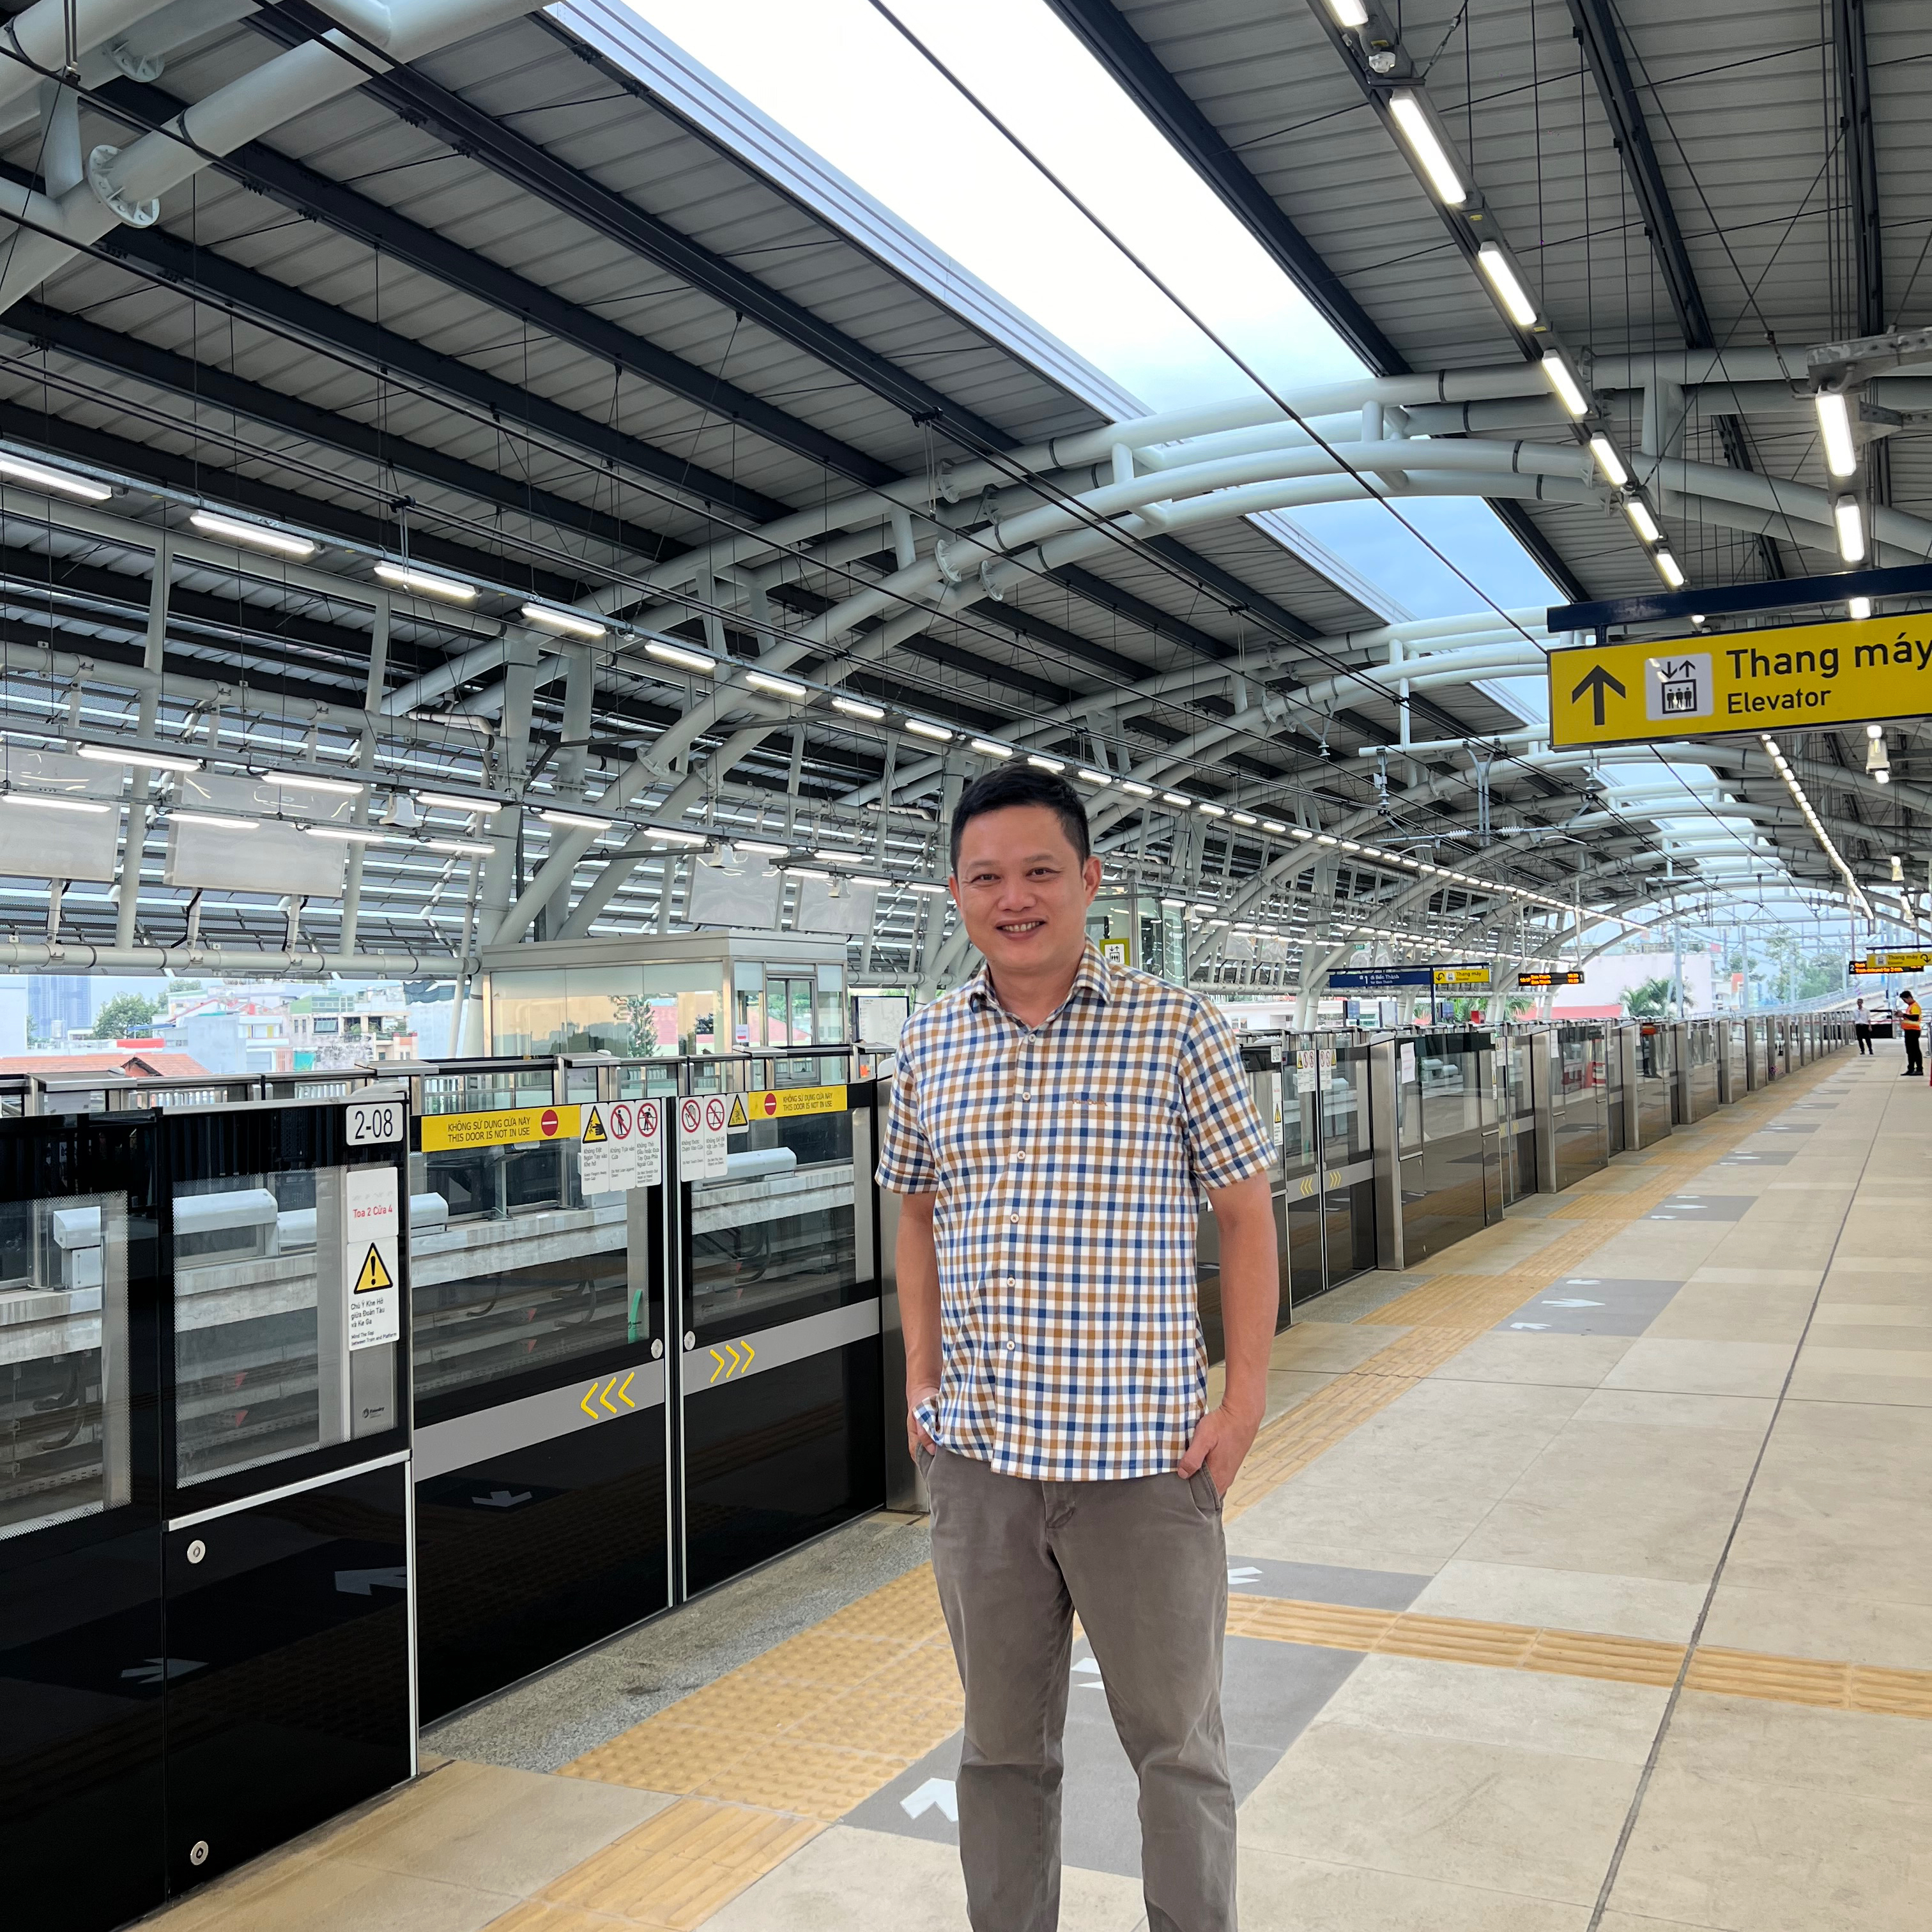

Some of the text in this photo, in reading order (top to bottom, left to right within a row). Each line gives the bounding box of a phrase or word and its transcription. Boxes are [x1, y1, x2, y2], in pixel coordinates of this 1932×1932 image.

[1726, 632, 1932, 679] Thang máy
[1728, 688, 1832, 714] Elevator
[355, 1108, 393, 1140] 2-08
[448, 1120, 471, 1132] KHÔNG
[484, 1119, 502, 1130] DỤNG
[448, 1127, 530, 1142] THIS DOOR IS NOT IN USE
[353, 1204, 393, 1218] Toa 2 Cửa 4
